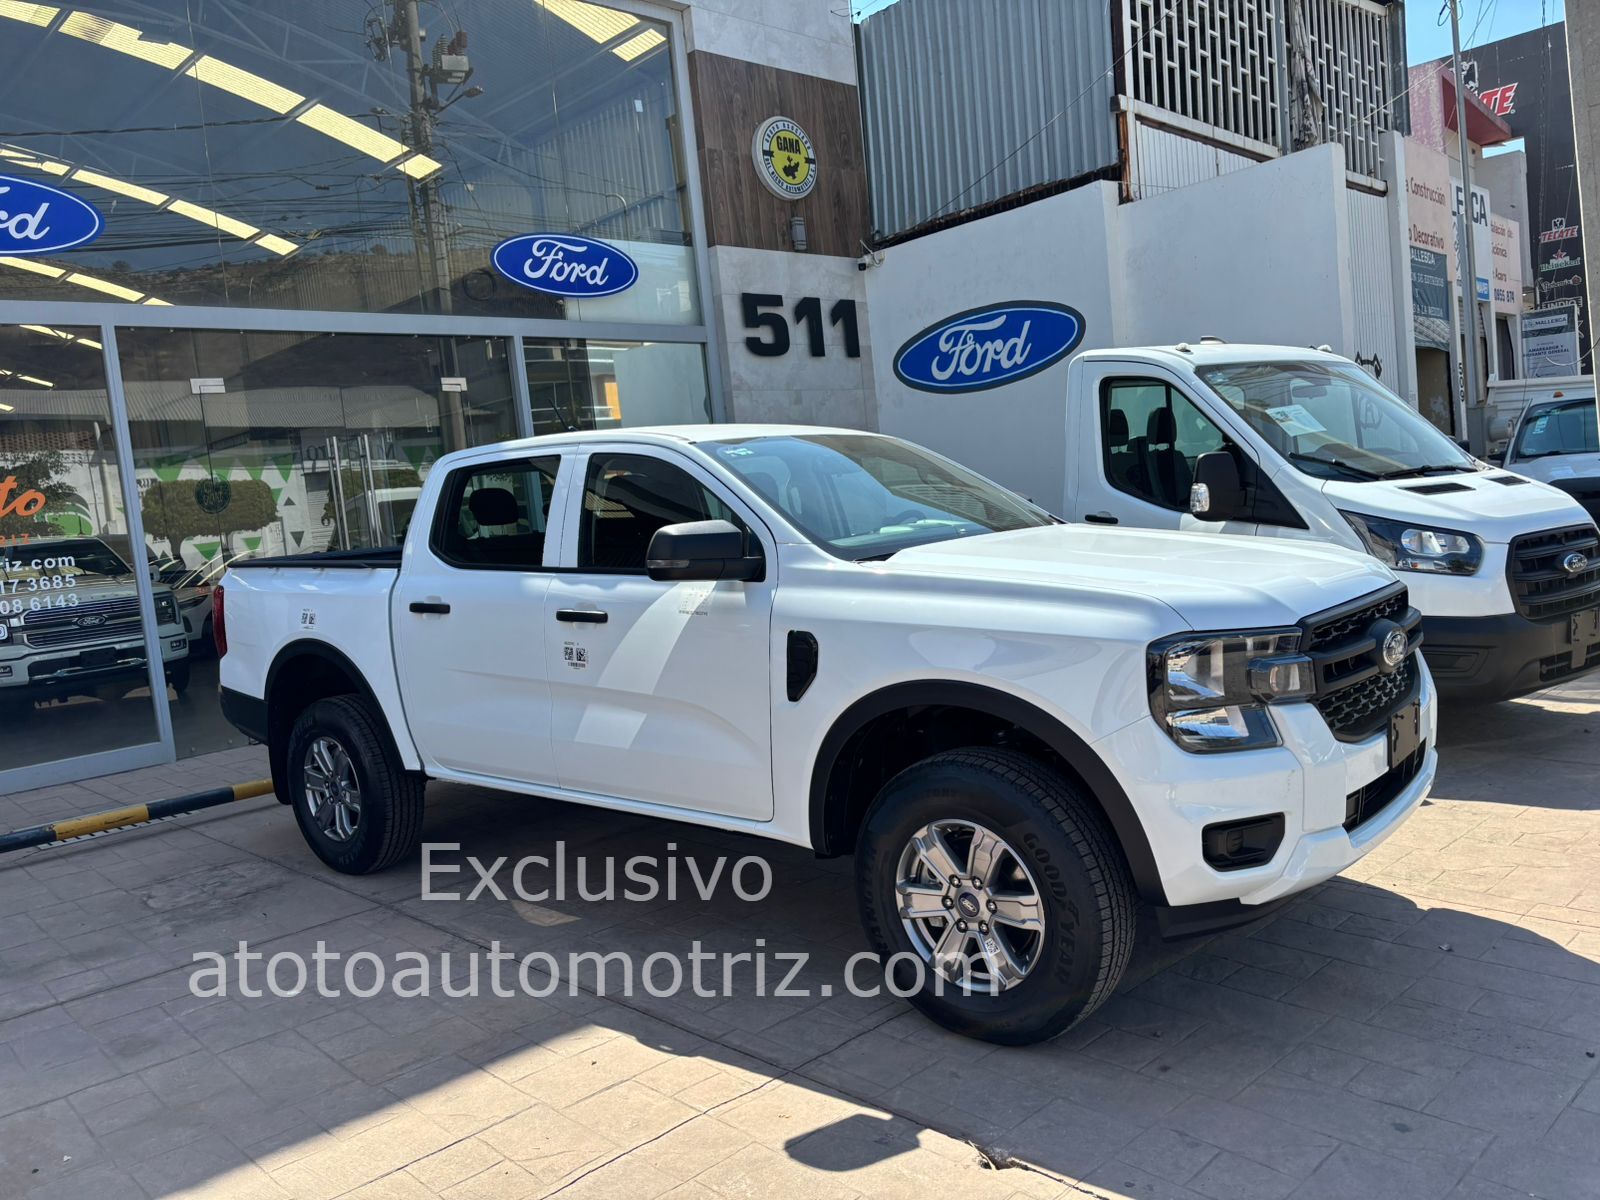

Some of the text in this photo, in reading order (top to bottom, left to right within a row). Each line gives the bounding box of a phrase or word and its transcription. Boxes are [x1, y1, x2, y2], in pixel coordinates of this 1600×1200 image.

[776, 136, 802, 155] GANA
[1410, 176, 1446, 206] Construcción
[1413, 224, 1444, 250] Decorativo
[1540, 226, 1578, 242] TECATE
[523, 239, 608, 286] Ford
[1540, 257, 1581, 272] Heineken
[742, 292, 860, 358] 511
[930, 314, 1032, 380] Ford
[0, 475, 46, 517] to
[28, 573, 76, 592] 3685
[0, 594, 79, 614] 08 6143
[1022, 832, 1080, 985] GOODYEAR
